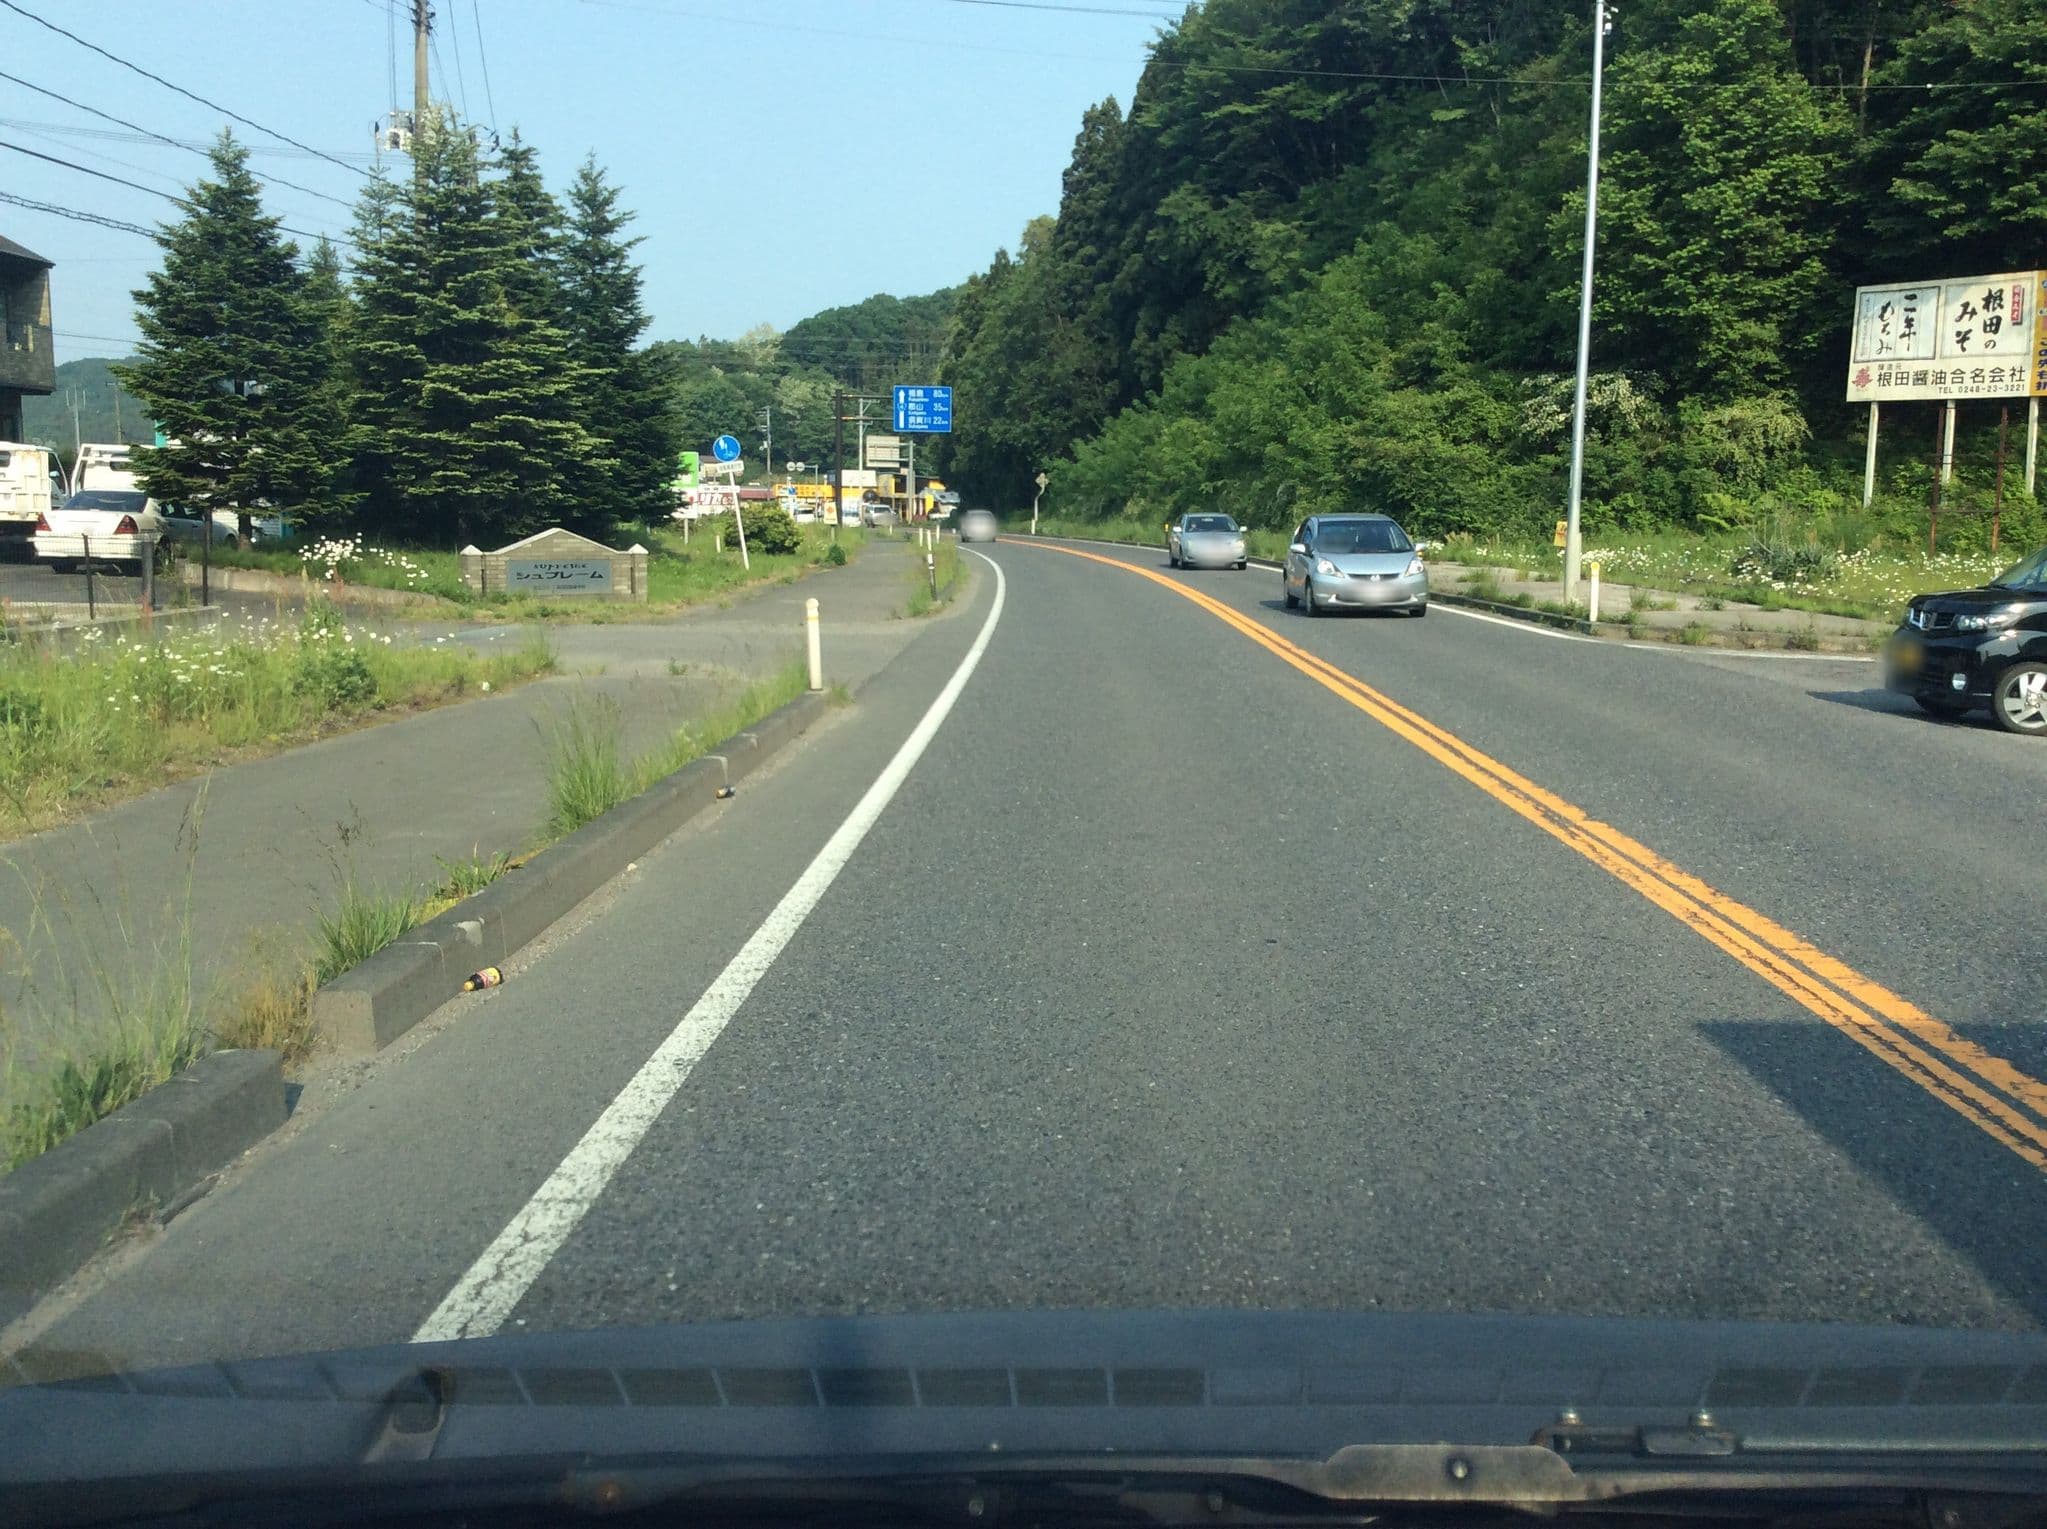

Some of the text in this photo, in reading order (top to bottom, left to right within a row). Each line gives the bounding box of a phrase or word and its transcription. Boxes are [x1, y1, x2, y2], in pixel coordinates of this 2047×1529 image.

[1955, 301, 1978, 353] みそ
[1981, 287, 2005, 350] 根田の
[1877, 365, 2026, 387] 根田醤油合名会社
[1938, 383, 2026, 394] TEL 0248-23-3221
[516, 571, 604, 580] シュプレーム
